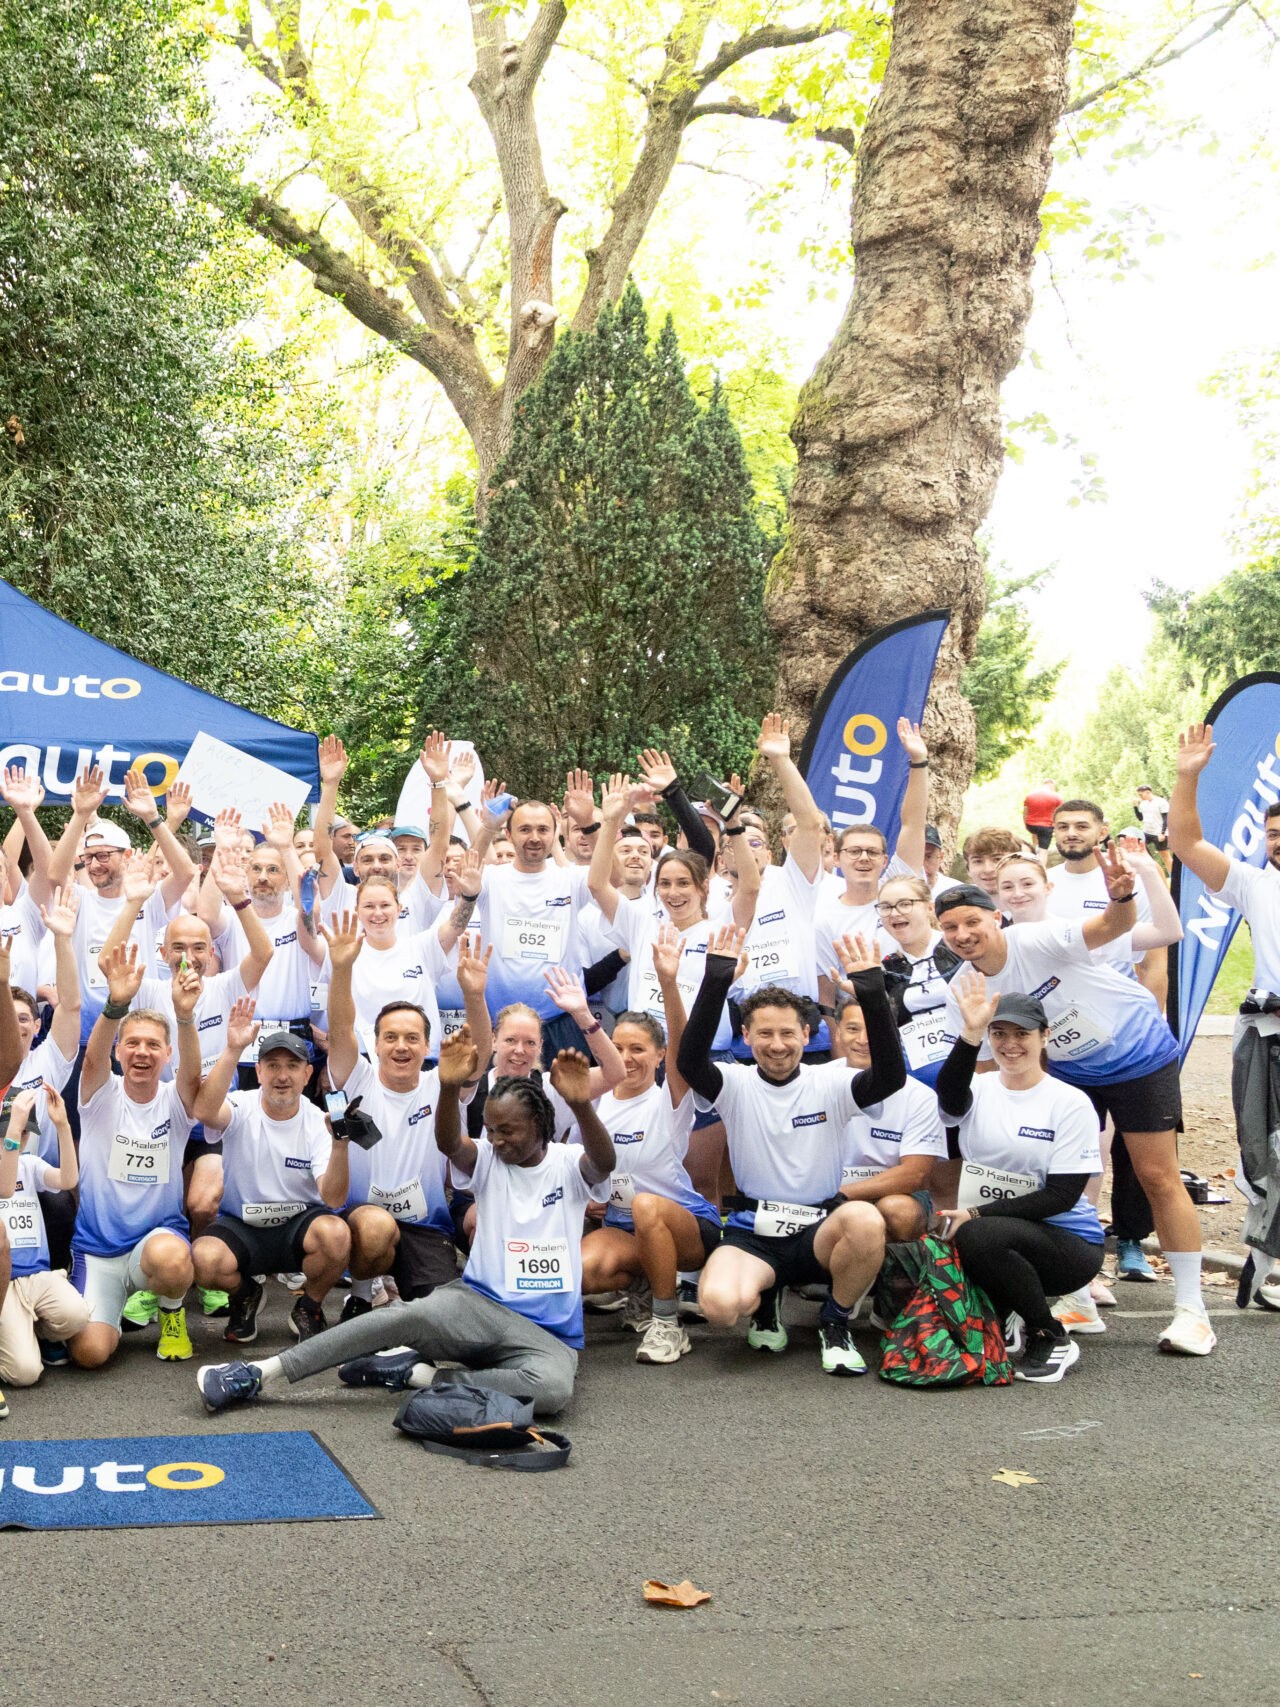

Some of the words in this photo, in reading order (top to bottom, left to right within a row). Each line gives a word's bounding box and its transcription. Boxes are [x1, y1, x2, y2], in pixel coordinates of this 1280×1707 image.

[760, 911, 784, 924] Noraut
[524, 918, 560, 931] Kalenji
[519, 933, 546, 946] 652
[751, 937, 790, 950] Kalenji
[752, 953, 779, 968] 729
[650, 989, 664, 1003] 76
[447, 1011, 467, 1019] Kale
[1050, 1008, 1079, 1031] alenji
[260, 1023, 287, 1031] alenji
[918, 1030, 945, 1048] 762
[1049, 1028, 1081, 1049] 795
[793, 1112, 826, 1127] Norauto
[872, 1129, 902, 1141] Noraut
[1020, 1128, 1053, 1141] Noraut
[132, 1139, 168, 1152] Kalenji
[126, 1154, 154, 1168] 773
[612, 1175, 629, 1186] enji
[987, 1169, 1035, 1188] Kalenji
[385, 1181, 420, 1198] Kalenji
[264, 1203, 305, 1214] Kalenji
[383, 1200, 411, 1214] 784
[782, 1205, 821, 1218] Kalen
[9, 1215, 33, 1230] 035
[532, 1244, 567, 1252] Kalenji
[518, 1258, 560, 1273] 1690
[518, 1279, 561, 1289] DECATHLON
